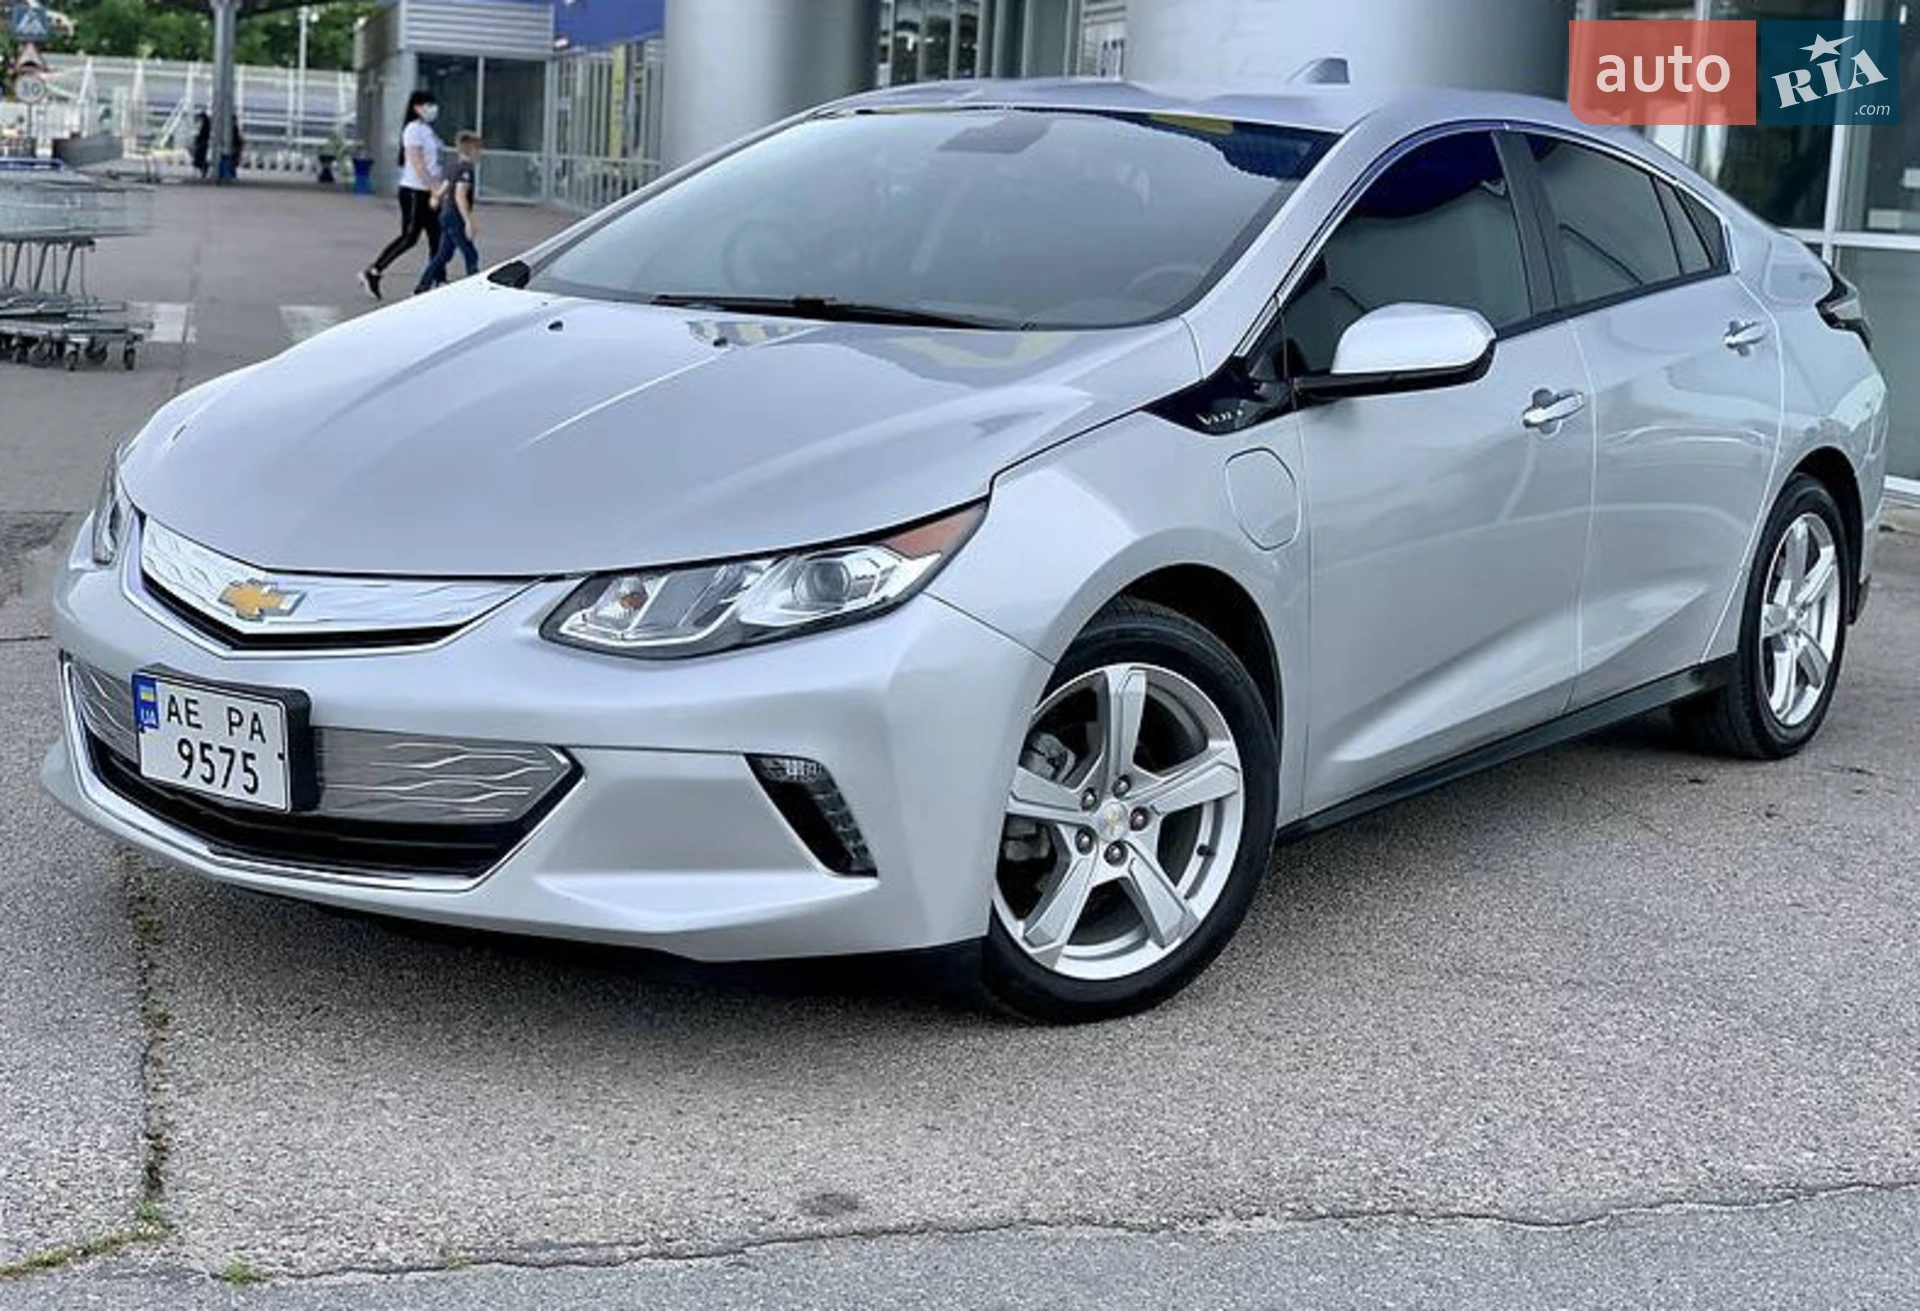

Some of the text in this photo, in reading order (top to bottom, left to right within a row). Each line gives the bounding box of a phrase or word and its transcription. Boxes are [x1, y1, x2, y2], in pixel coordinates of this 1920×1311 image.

[167, 694, 266, 744] AE PA
[177, 738, 259, 795] 9575
